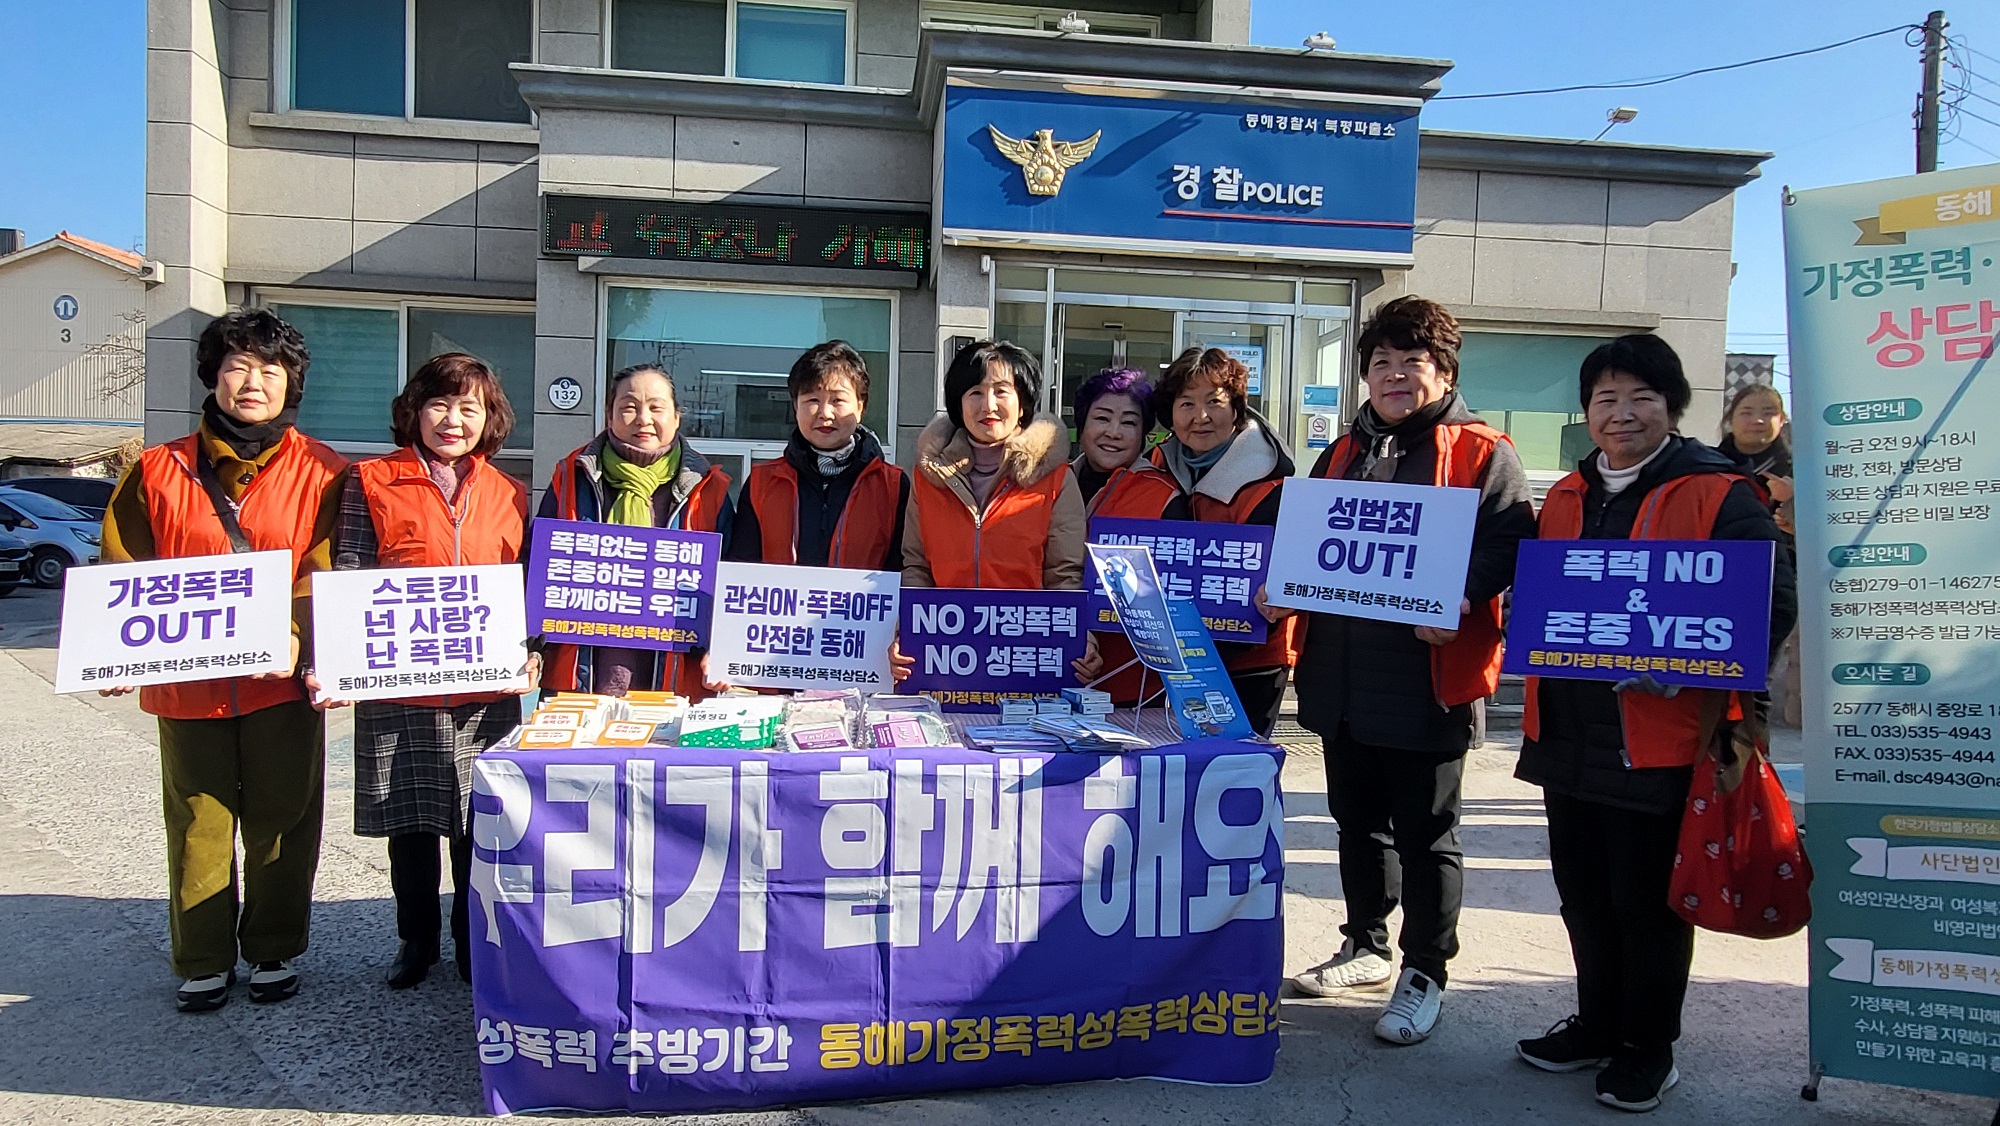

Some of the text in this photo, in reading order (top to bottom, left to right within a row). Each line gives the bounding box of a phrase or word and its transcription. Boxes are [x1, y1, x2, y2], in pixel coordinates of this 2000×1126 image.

[1245, 113, 1397, 138] 동해경찰서 북평파출소
[1172, 164, 1324, 207] 경찰 POLICE
[1934, 189, 1992, 222] 동해
[60, 328, 72, 344] 3
[1866, 300, 2000, 368] 상담
[554, 390, 577, 400] 132
[1838, 401, 1906, 421] 상담안내
[1824, 430, 1977, 455] 월~금 오전 9시~18시
[1825, 456, 1963, 479] 내방, 전화, 방문상담
[1873, 483, 1920, 501] 상담과
[1922, 480, 1971, 497] 지원은
[1327, 497, 1424, 537] 성범죄
[1875, 507, 1920, 524] 상담은
[1923, 506, 1956, 522] 비밀
[1958, 504, 1991, 521] 보장
[550, 530, 704, 566] 폭력없는 동해
[1317, 537, 1418, 580] OUT!
[1843, 546, 1910, 563] 후원안내
[547, 558, 702, 592] 존중하는 일상
[1563, 550, 1725, 584] 폭력 NO
[107, 567, 254, 609] 가정폭력
[372, 575, 479, 605] 스토킹!
[544, 585, 698, 619] 함께하는 우리
[1200, 574, 1251, 607] 폭력
[1283, 582, 1445, 615] 동해가정폭력성폭력상담소
[1626, 588, 1650, 613] &
[724, 584, 894, 622] 관심ON·폭력OFF
[1829, 600, 2000, 618] 동해가정폭력성폭력상담
[120, 606, 237, 647] OUT!
[364, 605, 491, 638] 넌 사랑?
[541, 618, 699, 644] 동해가정폭력성폭력상담소
[912, 603, 965, 635] NO
[973, 606, 1077, 638] 가정폭력
[1544, 611, 1734, 651] 존중 YES
[1938, 625, 1971, 640] 발급
[366, 636, 484, 669] 난 폭력!
[746, 623, 866, 659] 안전한 동해
[81, 651, 273, 681] 동해가정폭력성폭력상담소
[727, 663, 880, 684] 동해가정폭력성폭력상담소
[924, 644, 1063, 678] NO 성폭력
[1528, 650, 1745, 678] 동해가정폭력성폭력상담소
[1843, 665, 1918, 682] 오시는 길
[338, 668, 513, 691] 동해가정폭력성폭력상담소
[1833, 702, 2000, 718] 25777 동해시 중앙로 1
[1833, 724, 1992, 741] TEL. 033)535-4943
[1834, 746, 1996, 764] FAX. 033)535-4944
[1835, 769, 1891, 784] E-mail.
[470, 754, 1284, 955] 우리가 함께 해요
[1920, 852, 2000, 875] 사단법인
[1838, 889, 2000, 916] 여성인권신장과 여성복
[1933, 919, 2000, 940] 비영리법
[1850, 995, 1915, 1017] 가정폭력,
[1917, 1001, 1965, 1021] 성폭력
[1854, 1018, 1890, 1036] 수사,
[1891, 1022, 1939, 1041] 상담을
[477, 1018, 597, 1073] 성폭력
[612, 1025, 793, 1075] 추방기간
[1856, 1040, 1901, 1059] 만들기
[1905, 1046, 1936, 1064] 위한
[1938, 1050, 1987, 1070] 교육과
